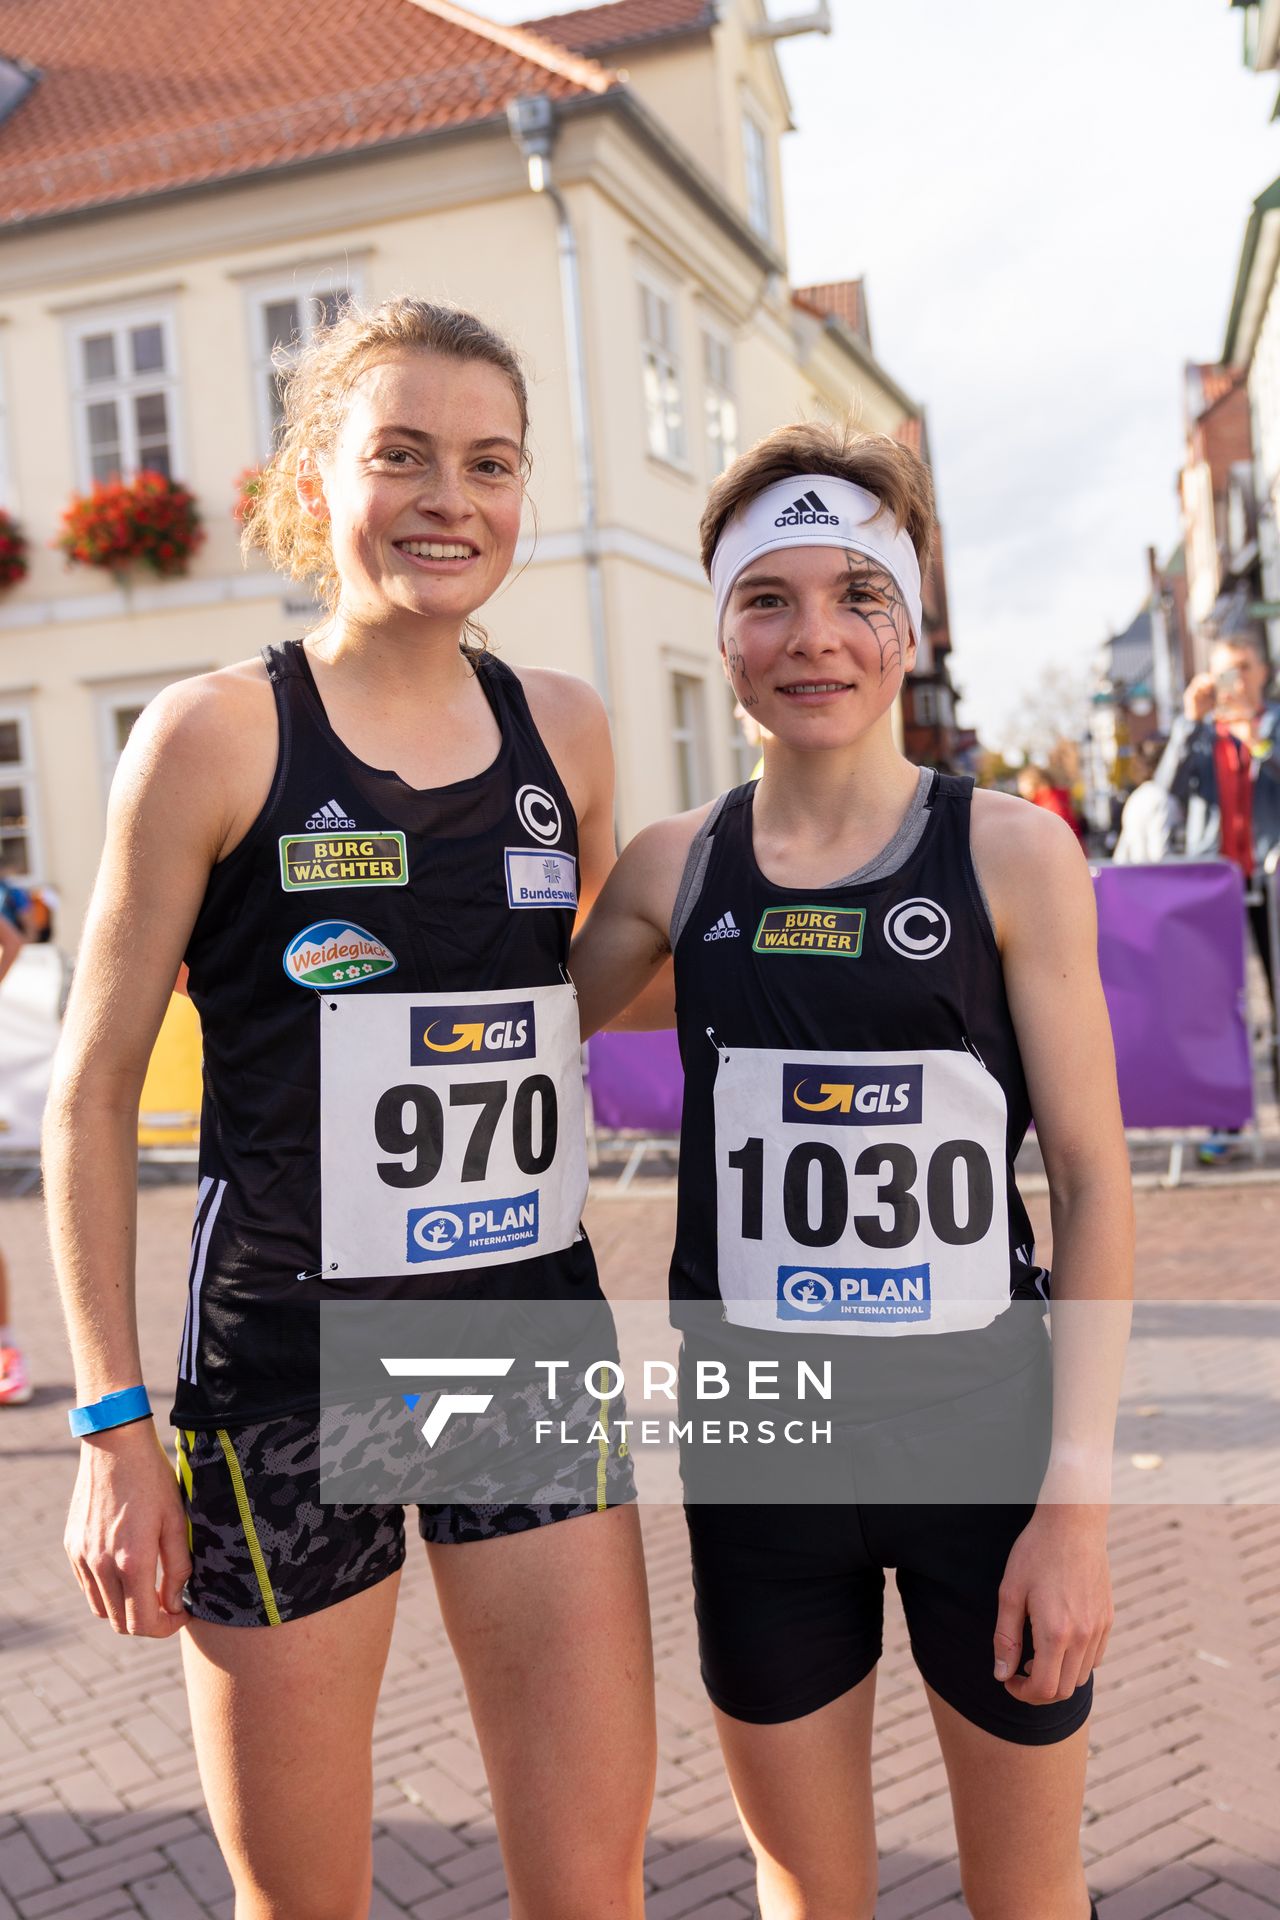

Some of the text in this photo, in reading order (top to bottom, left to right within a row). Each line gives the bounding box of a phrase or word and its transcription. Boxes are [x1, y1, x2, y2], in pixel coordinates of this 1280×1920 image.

[774, 511, 840, 527] adidas
[305, 816, 356, 830] adidas
[314, 841, 374, 858] BURG
[293, 859, 395, 881] WÄCHTER
[785, 913, 836, 929] BURG
[703, 926, 741, 942] adidas
[764, 928, 851, 950] WÄCHTER
[292, 941, 390, 972] Weideglück
[484, 1019, 528, 1050] GLS
[854, 1083, 910, 1113] GLS
[374, 1073, 558, 1189] 970
[728, 1136, 994, 1249] 1030
[469, 1203, 535, 1235] PLAN
[469, 1229, 534, 1248] INTERNATIONAL
[840, 1277, 923, 1301] PLAN
[841, 1305, 924, 1314] INTERNATIONAL
